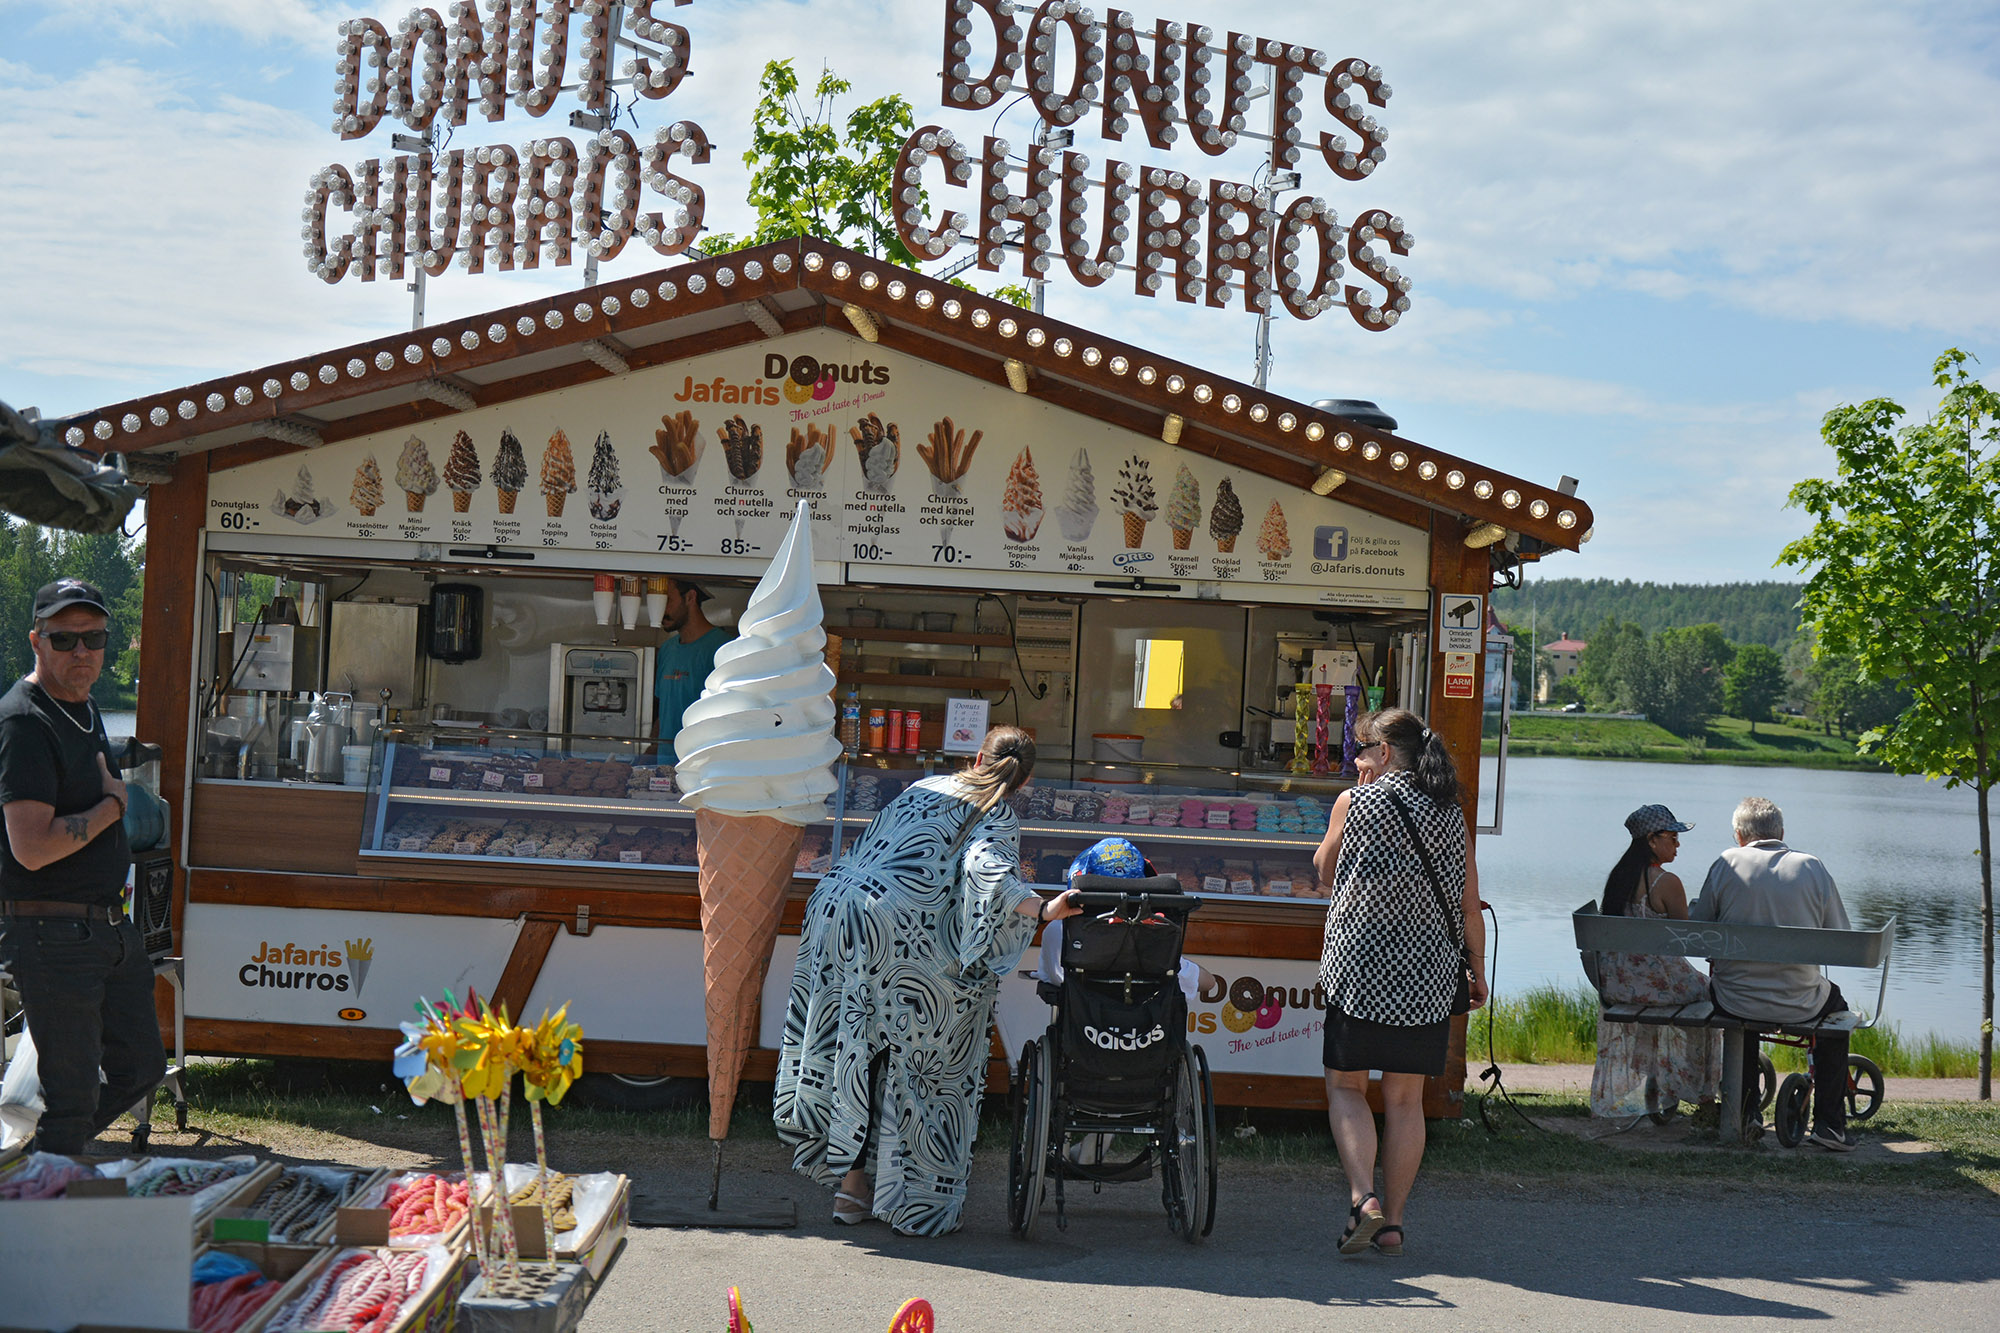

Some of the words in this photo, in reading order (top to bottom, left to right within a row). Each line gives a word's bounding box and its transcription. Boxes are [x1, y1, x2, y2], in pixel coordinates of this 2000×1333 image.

[941, 0, 1393, 182] DONUTS
[302, 121, 712, 285] CHURROS
[892, 125, 1414, 332] CHURROS
[674, 376, 780, 406] Jafaris
[790, 408, 810, 422] The
[812, 402, 830, 418] real
[832, 398, 851, 412] taste
[852, 393, 860, 408] of
[862, 390, 886, 403] Donuts
[658, 486, 697, 496] Churros
[725, 486, 764, 496] Churros
[786, 488, 827, 499] Churros
[666, 497, 688, 506] med
[856, 491, 896, 502] Churros
[928, 494, 968, 504] Churros
[210, 500, 260, 510] Donutglass
[714, 497, 736, 506] med
[738, 498, 774, 508] nutella
[844, 502, 867, 511] med
[870, 504, 906, 513] nutella
[664, 507, 688, 518] sirap
[716, 507, 734, 516] och
[737, 508, 770, 518] socker
[780, 510, 832, 520] mjlass
[920, 506, 943, 514] med
[946, 506, 974, 516] kanel
[220, 512, 260, 530] 60:-
[865, 514, 884, 522] och
[920, 516, 938, 525] och
[940, 517, 974, 526] socker
[346, 522, 388, 530] Hasselnötter
[398, 524, 430, 532] Maränger
[590, 523, 617, 531] Choklad
[848, 524, 900, 536] mjukglass
[358, 530, 376, 538] 50:-
[404, 531, 422, 539] 50:-
[494, 528, 521, 536] Topping
[541, 529, 568, 538] Topping
[590, 531, 618, 540] Topping
[453, 534, 470, 542] 50:-
[496, 536, 512, 544] 50:-
[542, 538, 560, 546] 50:-
[1350, 536, 1363, 546] Följ
[1372, 538, 1386, 546] gilla
[595, 541, 613, 549] 50:-
[656, 535, 694, 552] 75:-
[720, 538, 760, 554] 85:-
[1003, 544, 1040, 552] Jordgubbs
[852, 544, 892, 560] 100:-
[932, 545, 972, 563] 70:-
[1008, 552, 1036, 560] Topping
[1360, 548, 1398, 556] Facebook
[1059, 553, 1094, 562] Mjukglass
[1113, 552, 1154, 566] OREO
[1168, 554, 1199, 562] Karamell
[1009, 560, 1028, 568] 50:-
[1067, 564, 1085, 572] 40:-
[1311, 562, 1405, 576] @Jafaris.donuts
[1123, 566, 1141, 574] 50:-
[1174, 568, 1191, 576] 50:-
[1216, 571, 1234, 579] 50:-
[251, 941, 342, 967] Jafaris
[239, 964, 349, 992] Churros
[1228, 1038, 1251, 1054] The
[1255, 1031, 1277, 1047] real
[1278, 1024, 1300, 1042] taste
[1302, 1022, 1311, 1038] of
